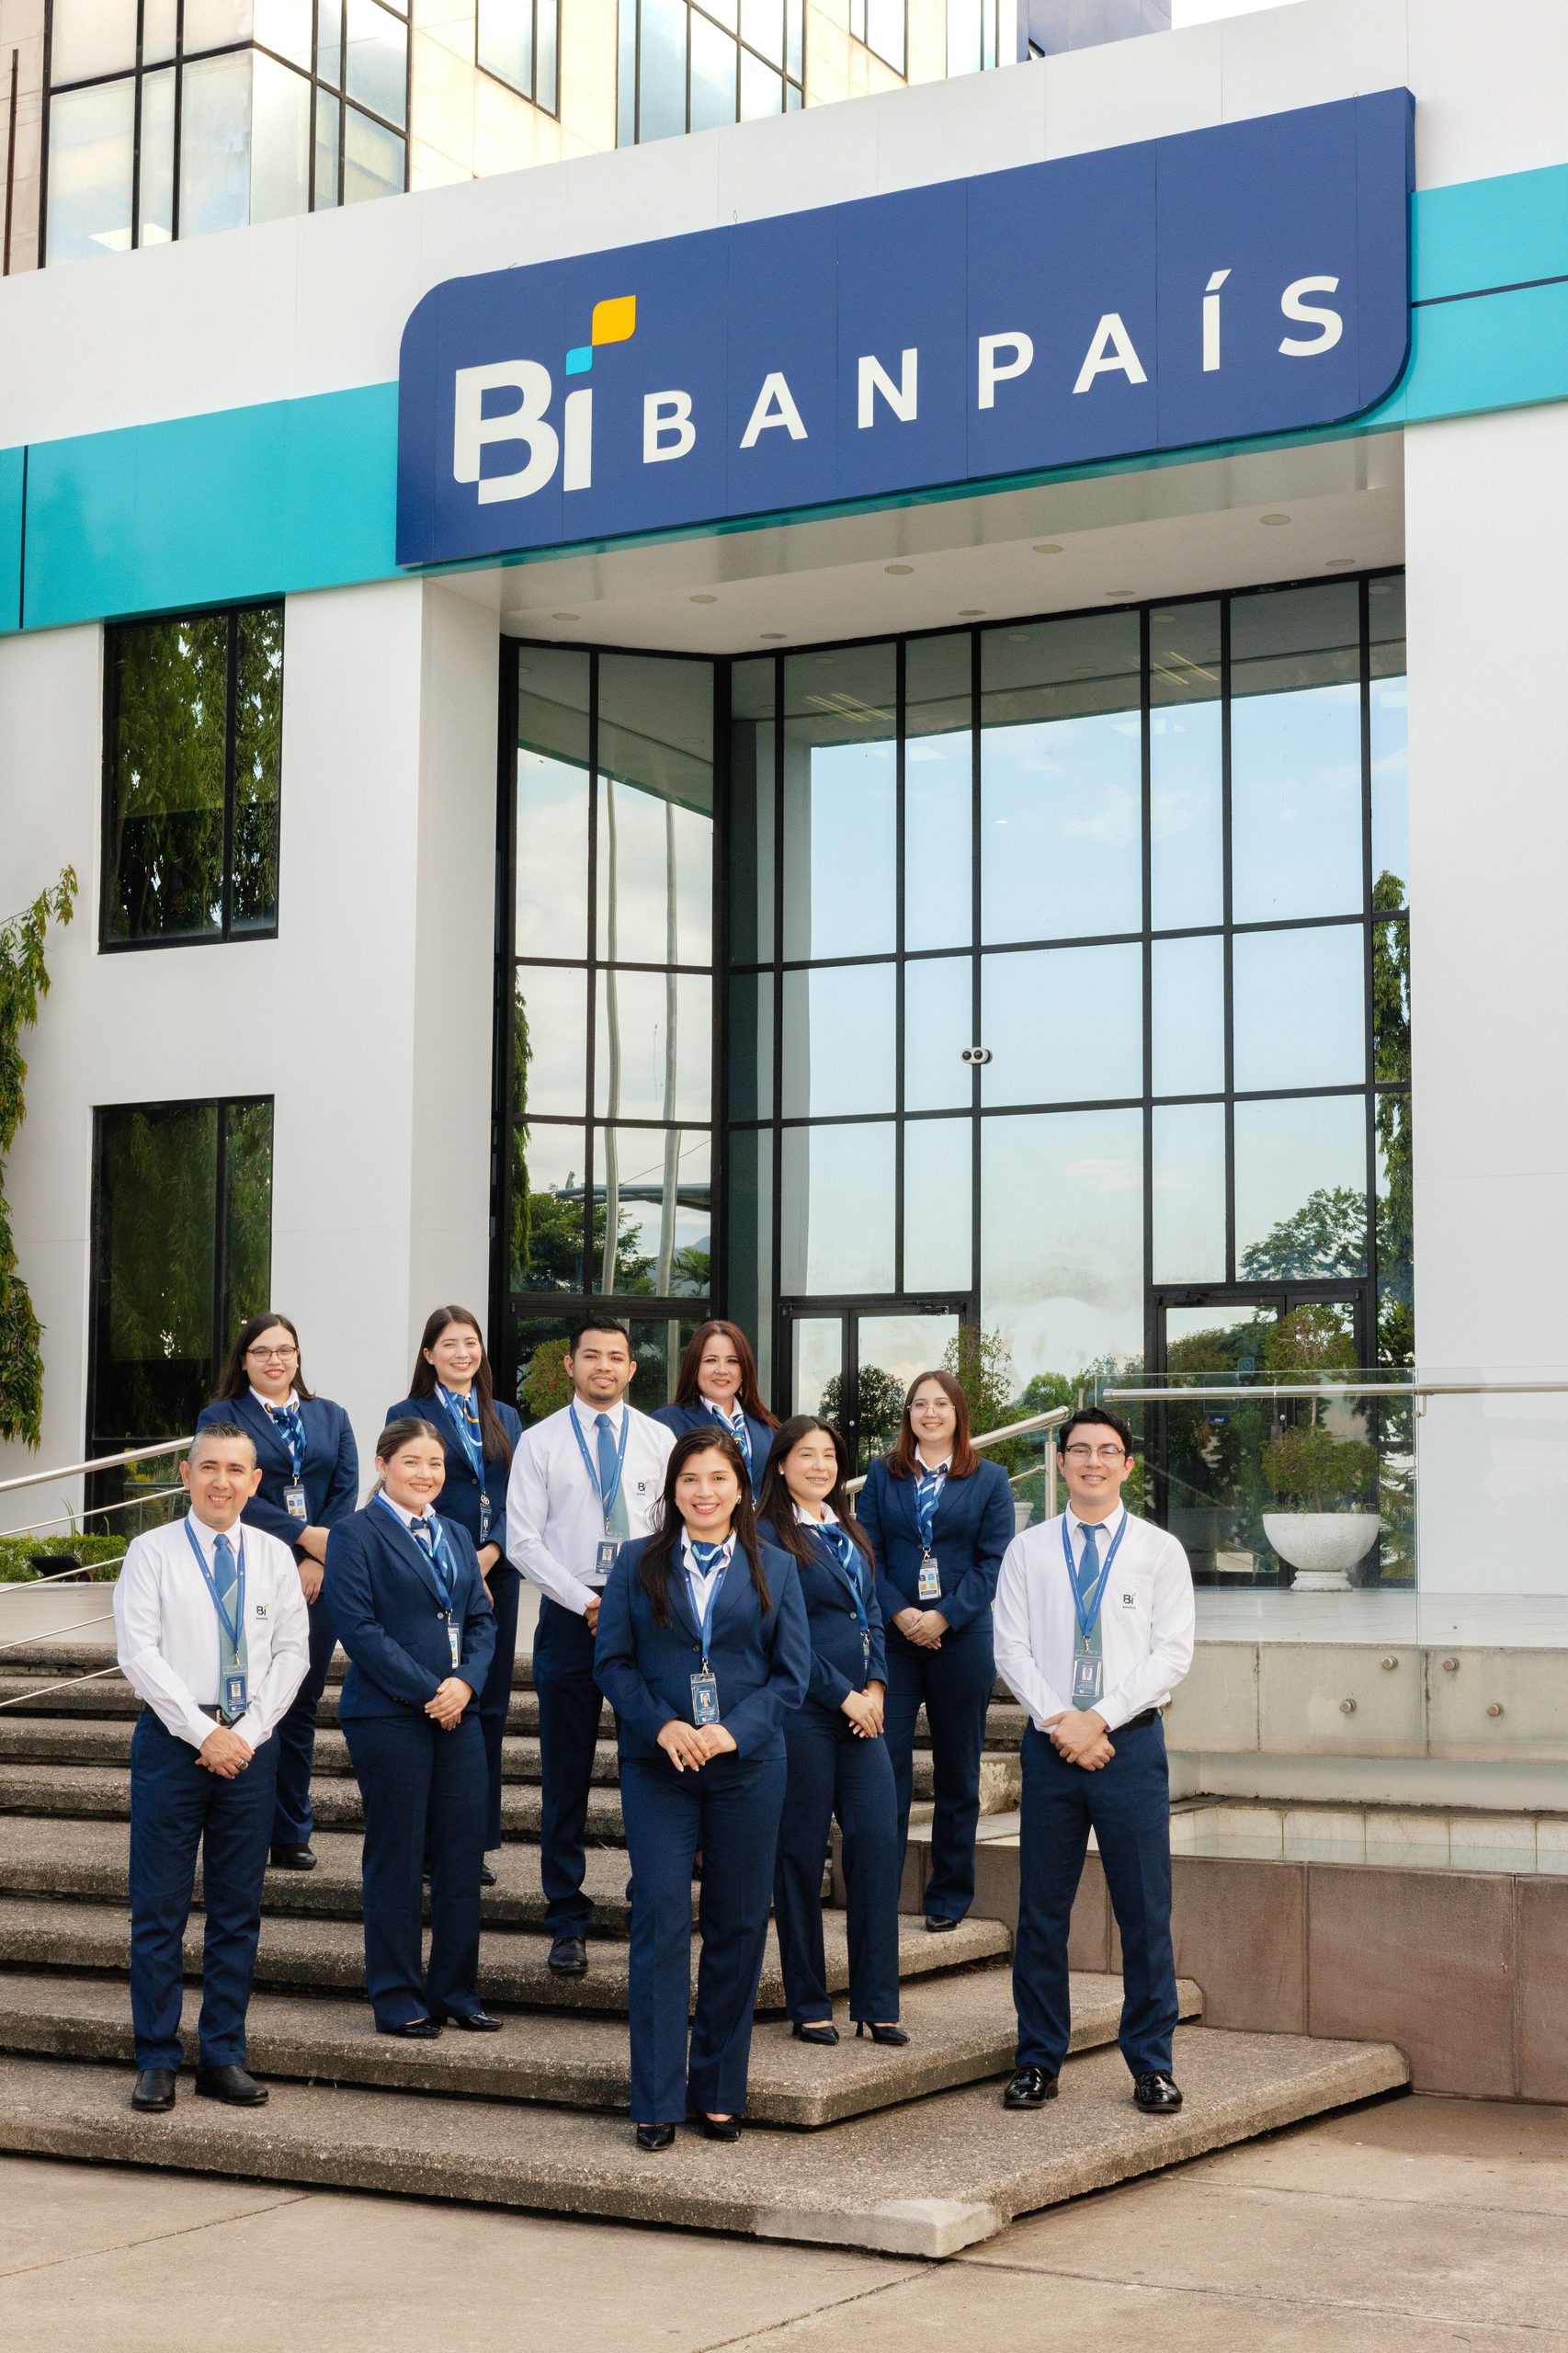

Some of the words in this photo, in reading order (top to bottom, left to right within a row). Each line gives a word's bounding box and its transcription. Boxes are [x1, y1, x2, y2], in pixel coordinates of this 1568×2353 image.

[454, 347, 593, 504] Bi
[643, 269, 1343, 464] BANPAÍS
[1122, 1594, 1134, 1605] Bi
[256, 1605, 267, 1616] Bi
